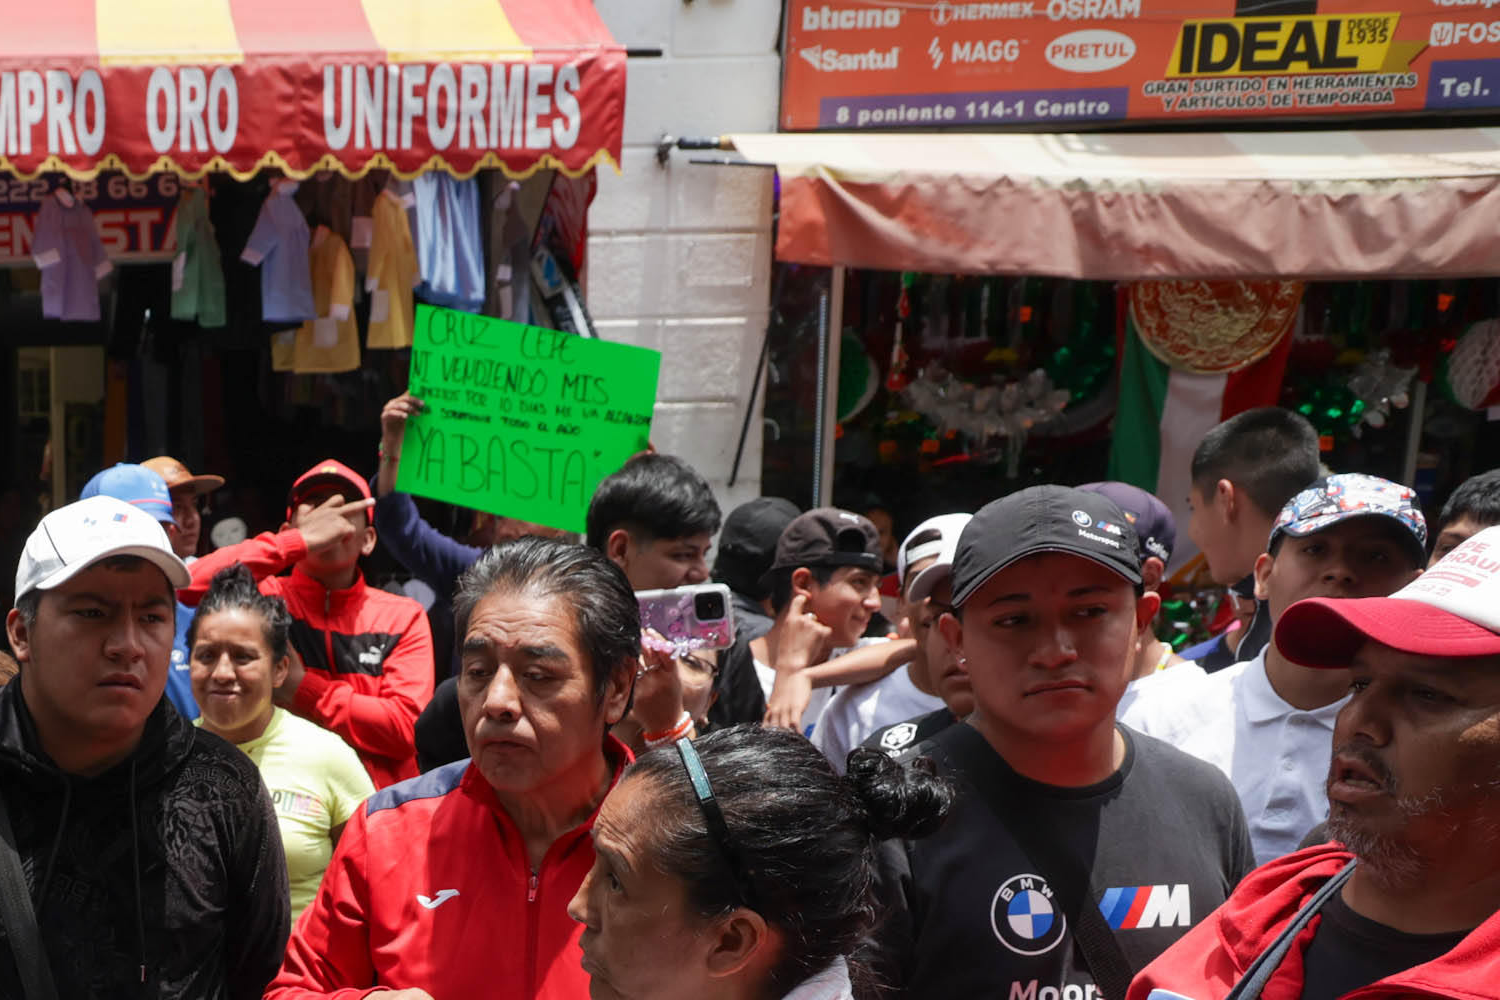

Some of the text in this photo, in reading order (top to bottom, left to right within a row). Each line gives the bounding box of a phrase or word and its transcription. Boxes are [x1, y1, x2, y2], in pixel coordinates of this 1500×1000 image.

[802, 6, 900, 30] bticino
[1046, 0, 1141, 20] OSRAM
[1346, 17, 1389, 31] DESDE
[1178, 19, 1359, 74] IDEAL
[1346, 28, 1388, 45] 1935
[822, 46, 899, 72] Santul
[951, 40, 1020, 63] MAGG
[1051, 42, 1129, 59] PRETUL
[1144, 72, 1418, 96] GRAN SURTIDO EN HERRAMIENTAS
[1440, 76, 1490, 97] Tel.
[146, 66, 239, 154] ORO
[323, 63, 581, 151] UNIFORMES
[1163, 97, 1175, 111] Y
[1271, 92, 1291, 106] DE
[1296, 89, 1394, 105] TEMPORADA
[836, 99, 1111, 127] 8 poniente 114-1 Centro
[560, 372, 610, 406] MIS
[1001, 877, 1054, 902] BMW
